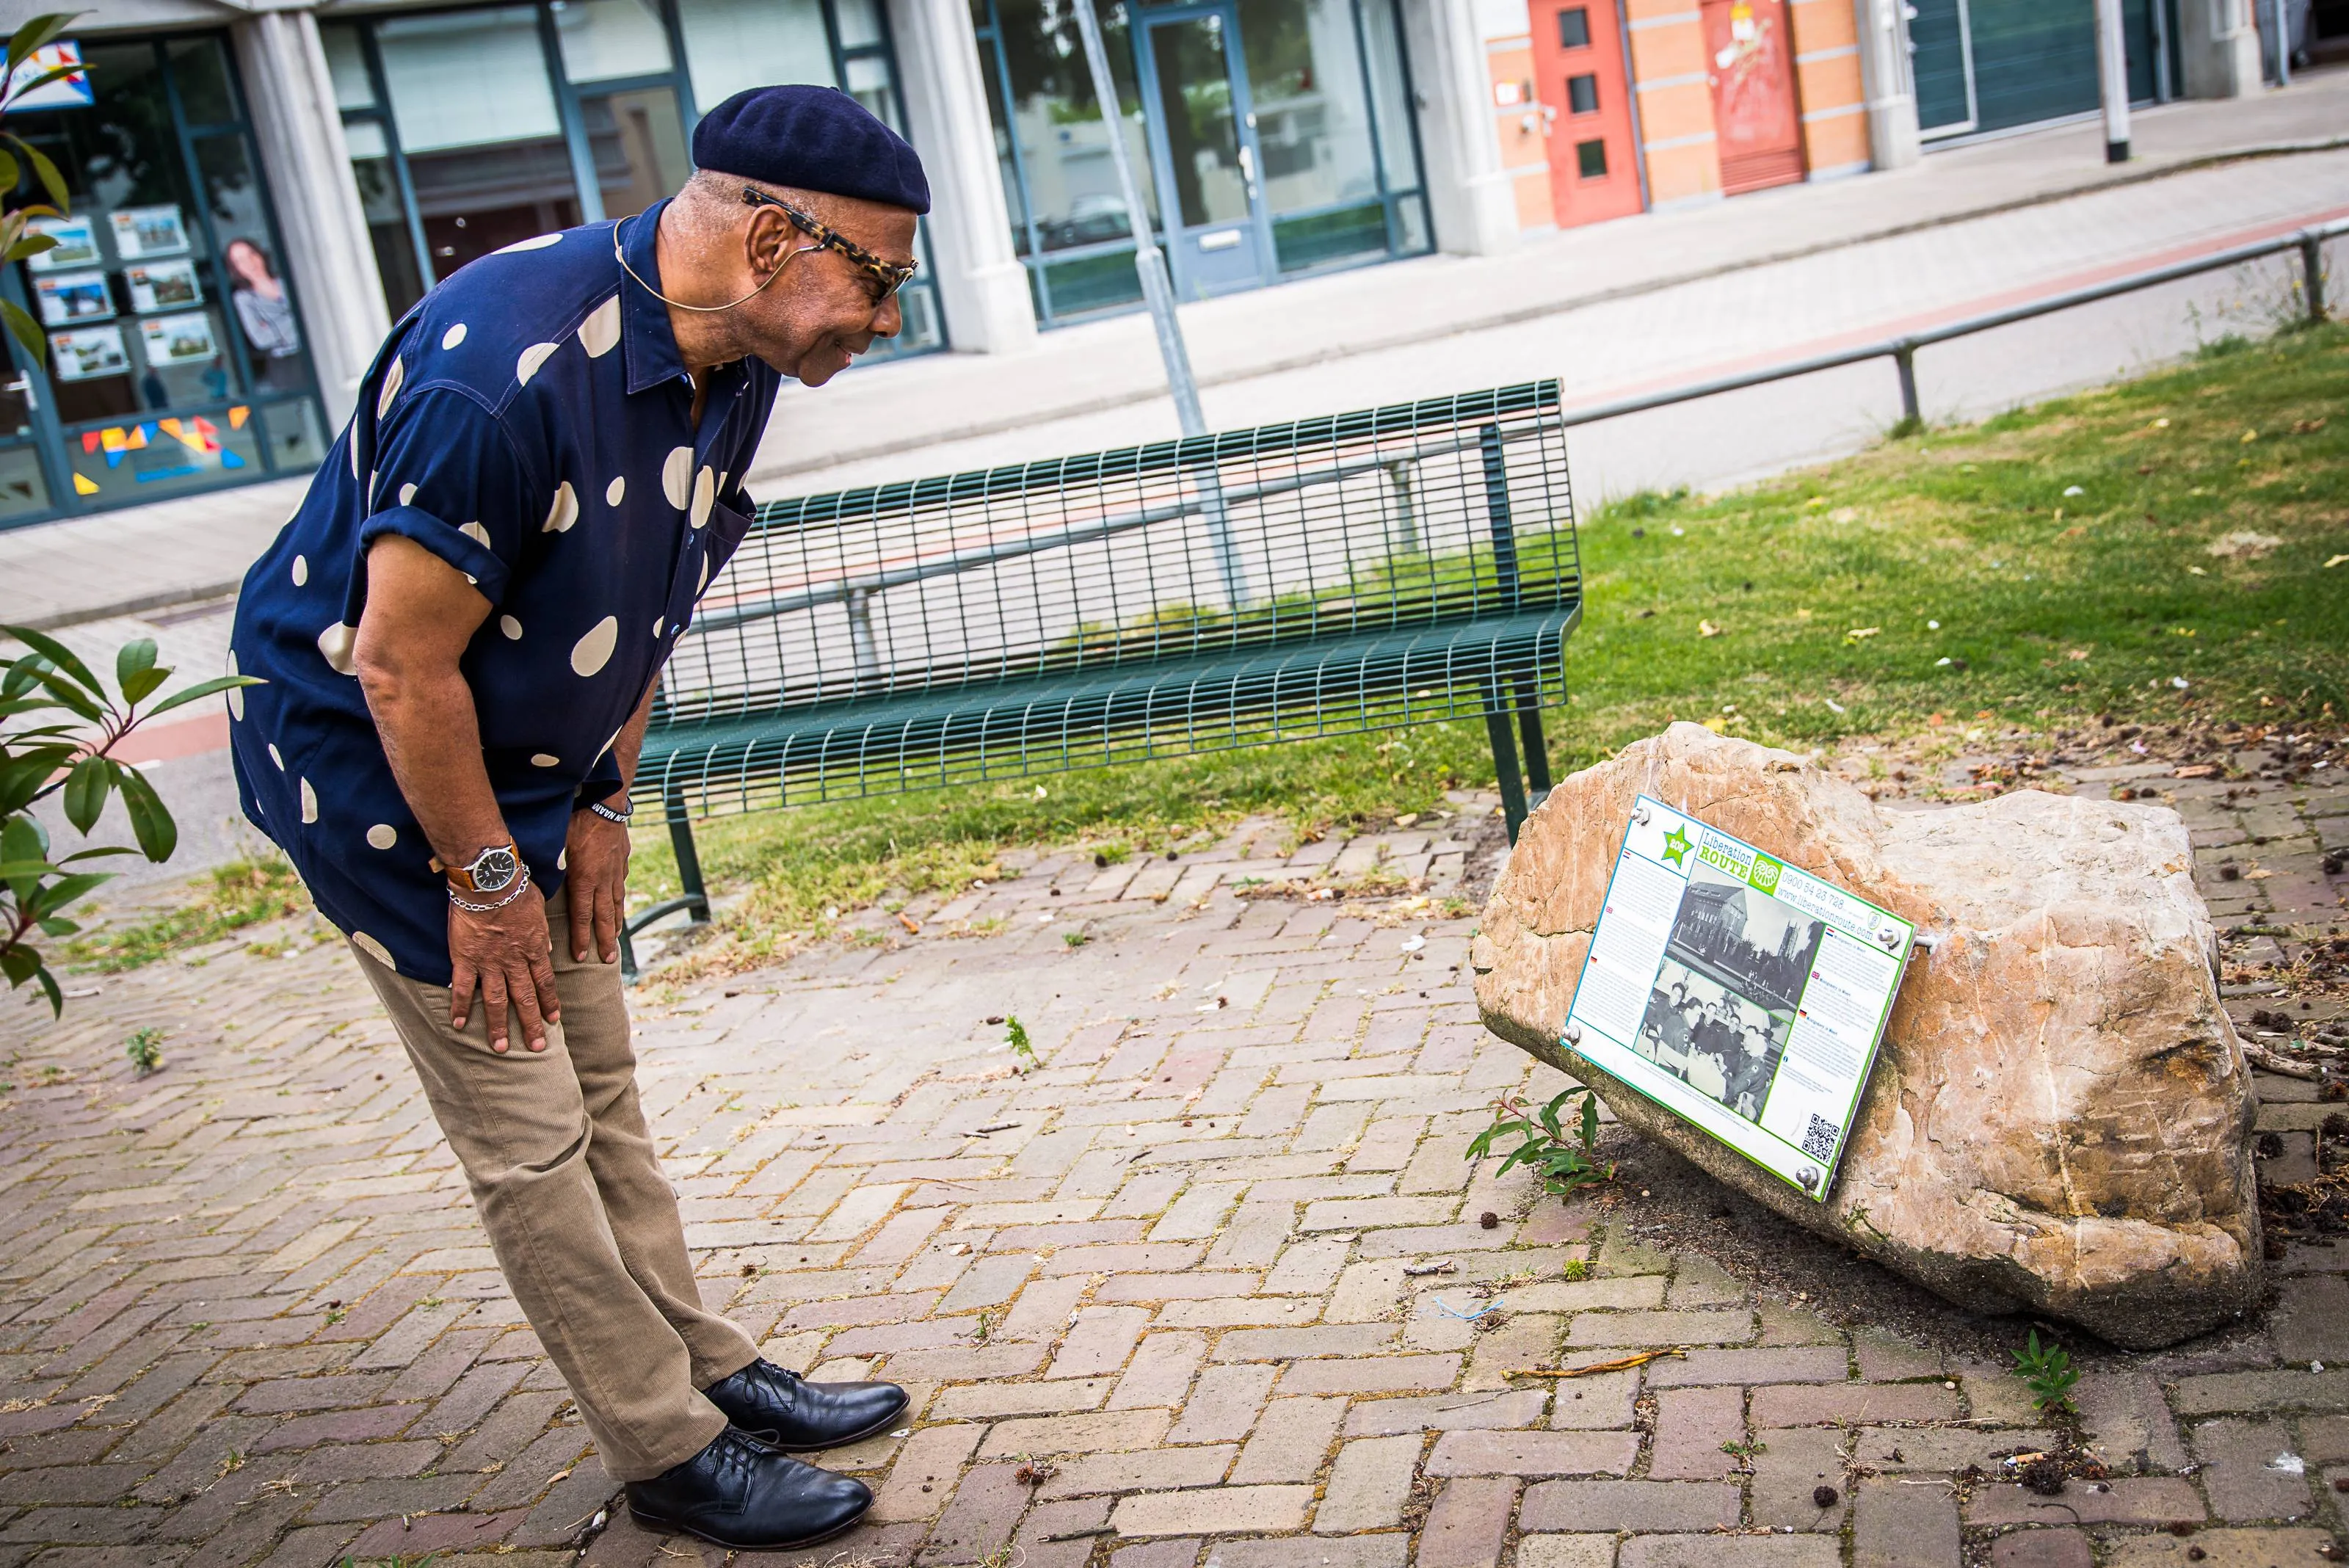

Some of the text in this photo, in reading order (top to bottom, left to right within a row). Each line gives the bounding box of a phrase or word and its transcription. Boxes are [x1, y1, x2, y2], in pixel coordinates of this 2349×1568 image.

[592, 803, 617, 819] NAAM
[1669, 838, 1685, 853] 208
[1703, 832, 1751, 865] Liberation
[1699, 846, 1749, 879] ROUTE
[1782, 872, 1803, 889] 0900
[1815, 888, 1827, 901] 23
[1829, 894, 1845, 910] 728
[1778, 888, 1873, 940] www.liberationroute.com
